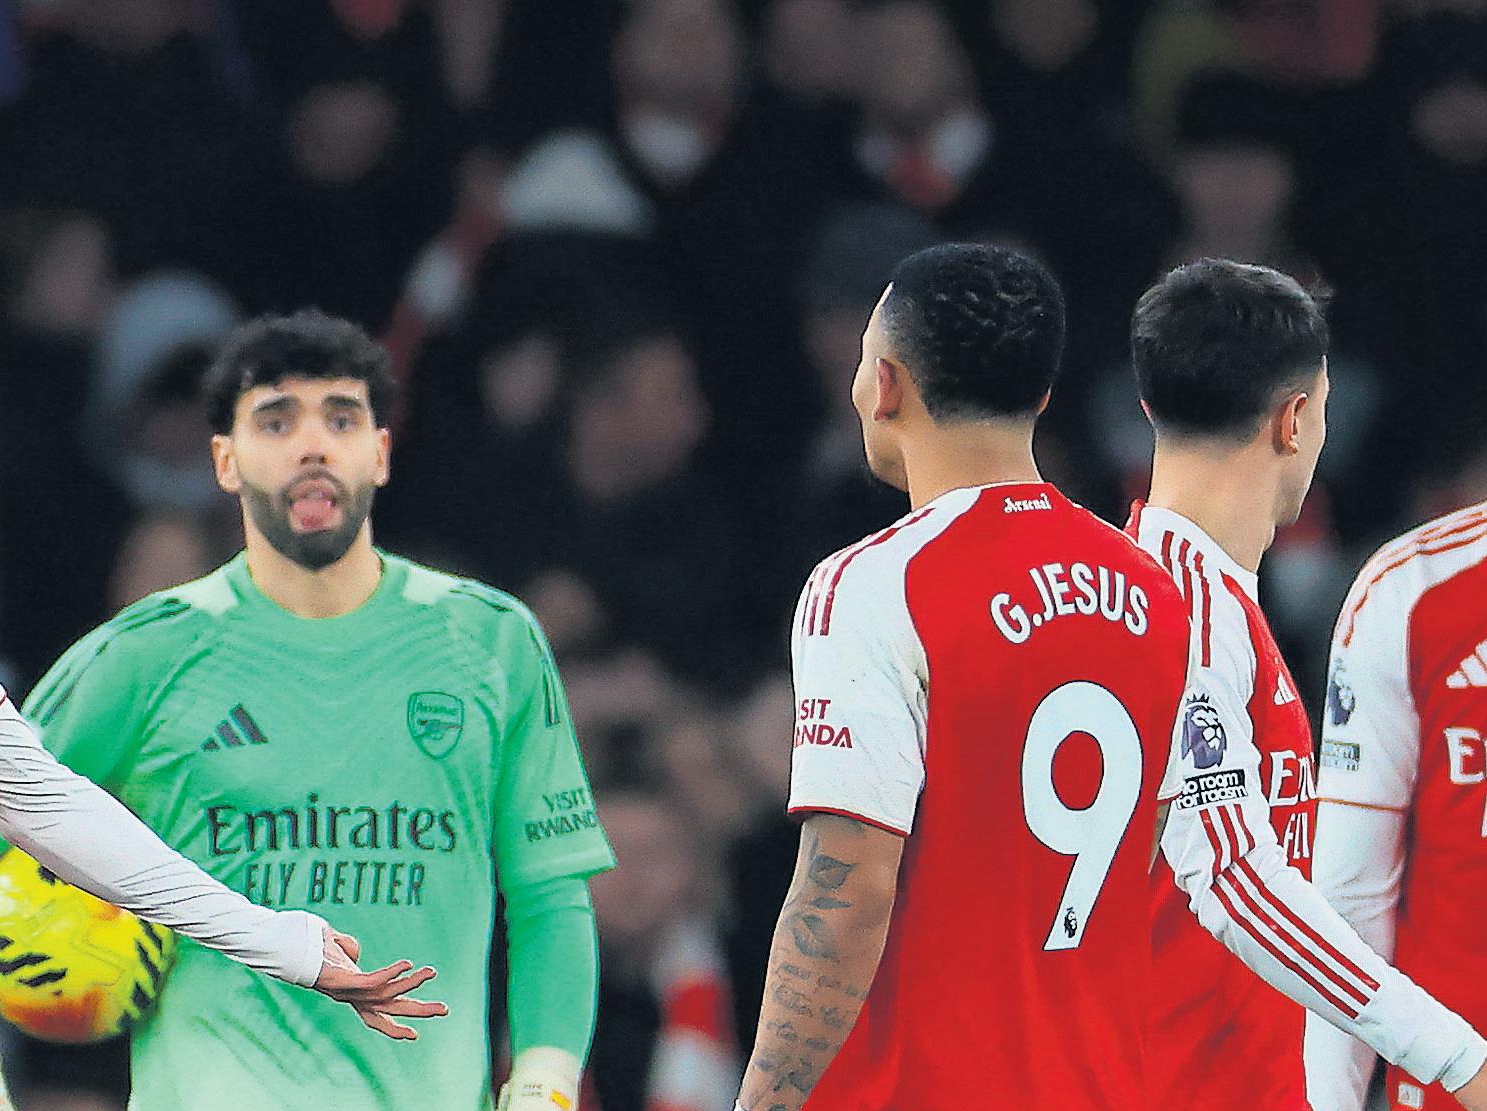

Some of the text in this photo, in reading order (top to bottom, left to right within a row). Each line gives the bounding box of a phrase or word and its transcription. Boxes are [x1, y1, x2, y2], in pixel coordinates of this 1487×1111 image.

[1004, 493, 1053, 513] Arsenal
[990, 562, 1149, 644] G.JESUS
[800, 699, 831, 720] SIT
[1199, 772, 1239, 790] room
[207, 792, 456, 857] Emirates
[525, 811, 598, 842] RWAND
[1021, 680, 1144, 951] 9
[247, 860, 426, 906] FLY BETTER
